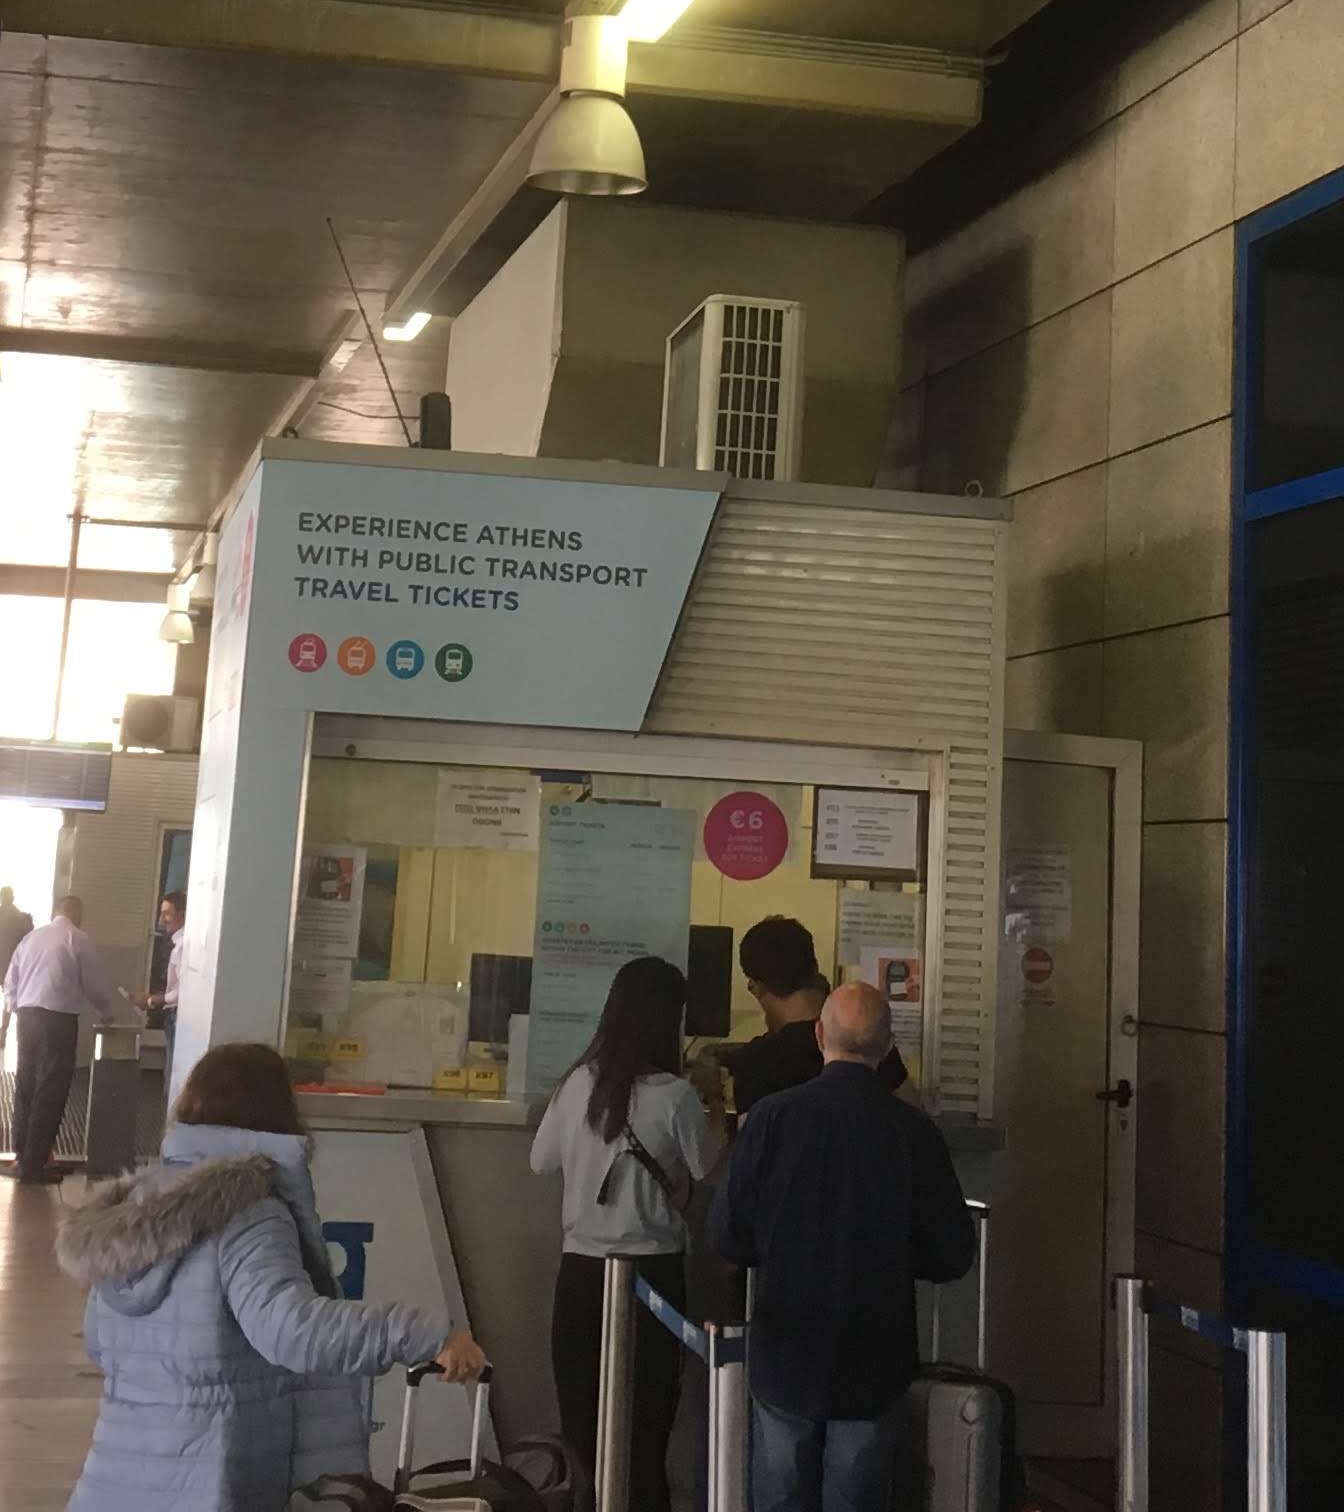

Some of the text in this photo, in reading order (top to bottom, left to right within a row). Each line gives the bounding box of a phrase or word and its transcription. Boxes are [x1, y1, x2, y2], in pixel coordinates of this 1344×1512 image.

[298, 512, 583, 551] EXPERIENCE ATHENS
[297, 544, 648, 588] WITH PUBLIC TRANSPORT
[295, 576, 520, 611] TRAVEL TICKETS
